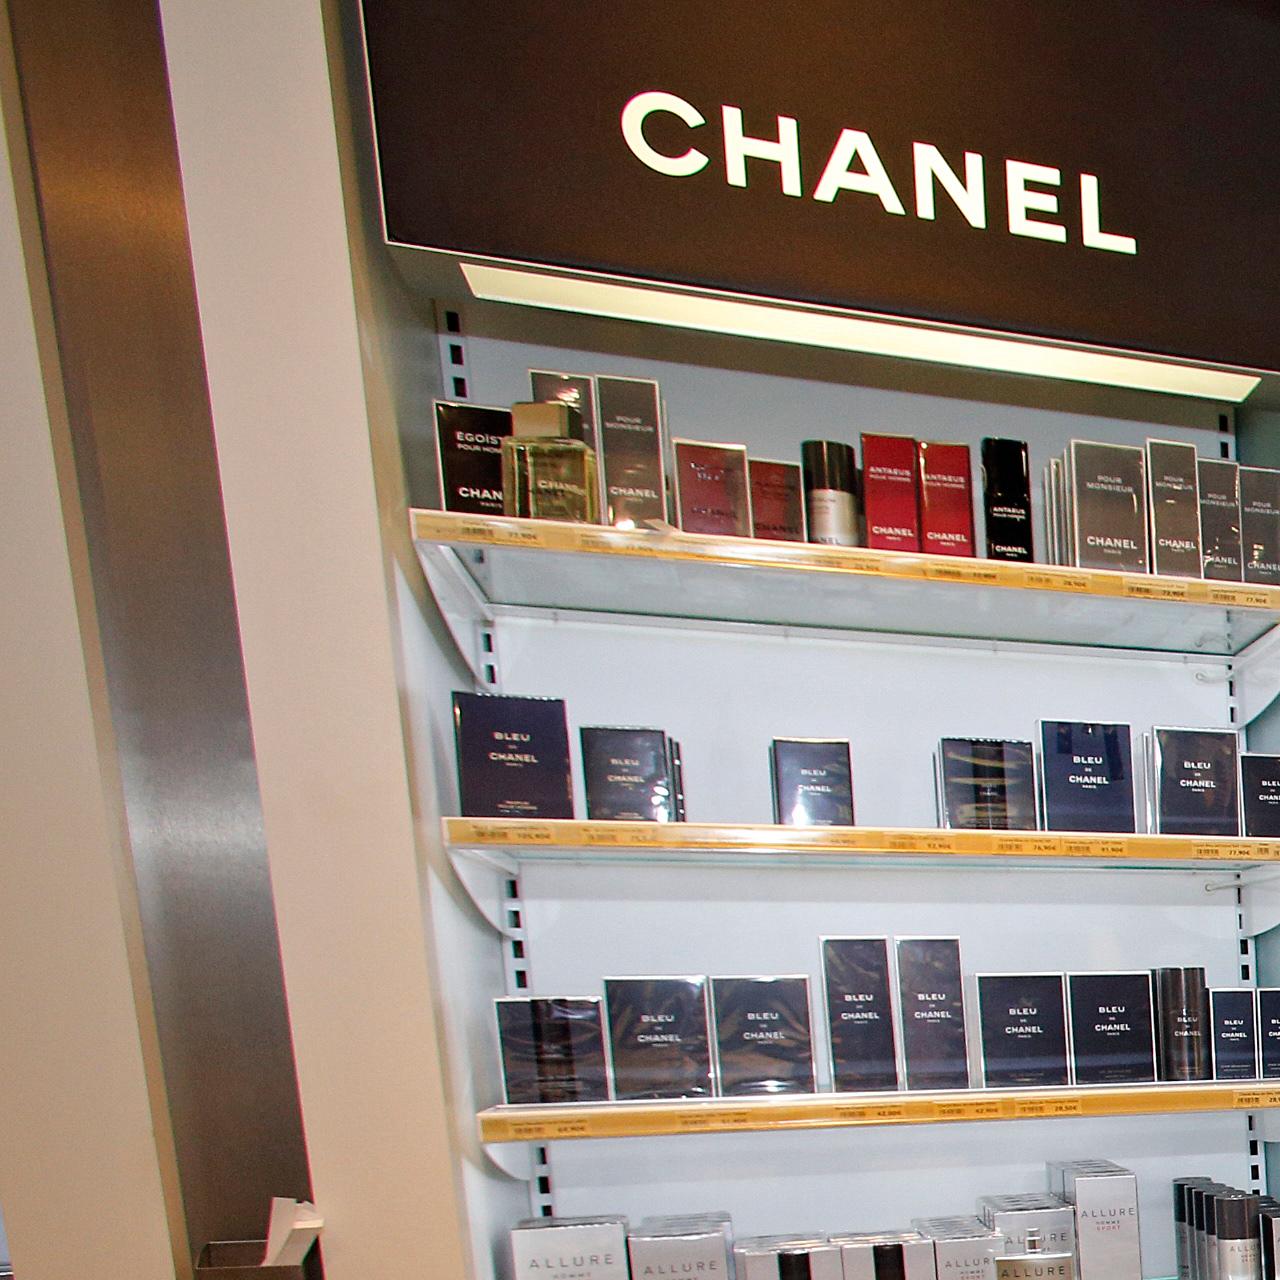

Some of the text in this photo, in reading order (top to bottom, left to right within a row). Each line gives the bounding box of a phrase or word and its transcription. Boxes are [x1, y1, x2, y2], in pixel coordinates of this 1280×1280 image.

[621, 91, 1136, 254] CHANEL
[869, 466, 911, 476] ANTAEUS
[1097, 474, 1122, 484] POUR
[1163, 475, 1184, 483] POUR
[1086, 482, 1134, 493] MONSIEUR
[459, 487, 503, 500] CHAN
[610, 486, 659, 499] CHANEL
[872, 526, 914, 537] CHANEL
[926, 531, 967, 542] CHANEL
[1086, 536, 1137, 550] CHANEL
[1159, 539, 1196, 549] CHANEL
[995, 546, 1027, 554] CHANEL
[493, 732, 530, 742] BLEU
[489, 752, 538, 764] CHANEL
[1073, 756, 1103, 764] BLEU
[607, 774, 645, 783] CHANEL
[1068, 775, 1109, 784] CHANEL
[1180, 780, 1216, 788] CHANEL
[798, 785, 832, 793] CHANEL
[917, 993, 945, 1001] BLEU
[914, 1010, 952, 1019] CHANEL
[1009, 1008, 1037, 1016] BLEU
[1099, 1006, 1125, 1014] BLEU
[641, 1014, 675, 1022] BLEU
[747, 1012, 779, 1020] BLEU
[841, 1011, 879, 1019] CHANEL
[1005, 1026, 1043, 1034] CHANEL
[1094, 1023, 1131, 1032] CHANEL
[637, 1033, 681, 1042] CHANEL
[1082, 1208, 1135, 1218] ALLURE
[529, 1254, 614, 1268] ALLURE
[643, 1261, 717, 1274] ALLURE
[1002, 1266, 1065, 1277] ALLURE
